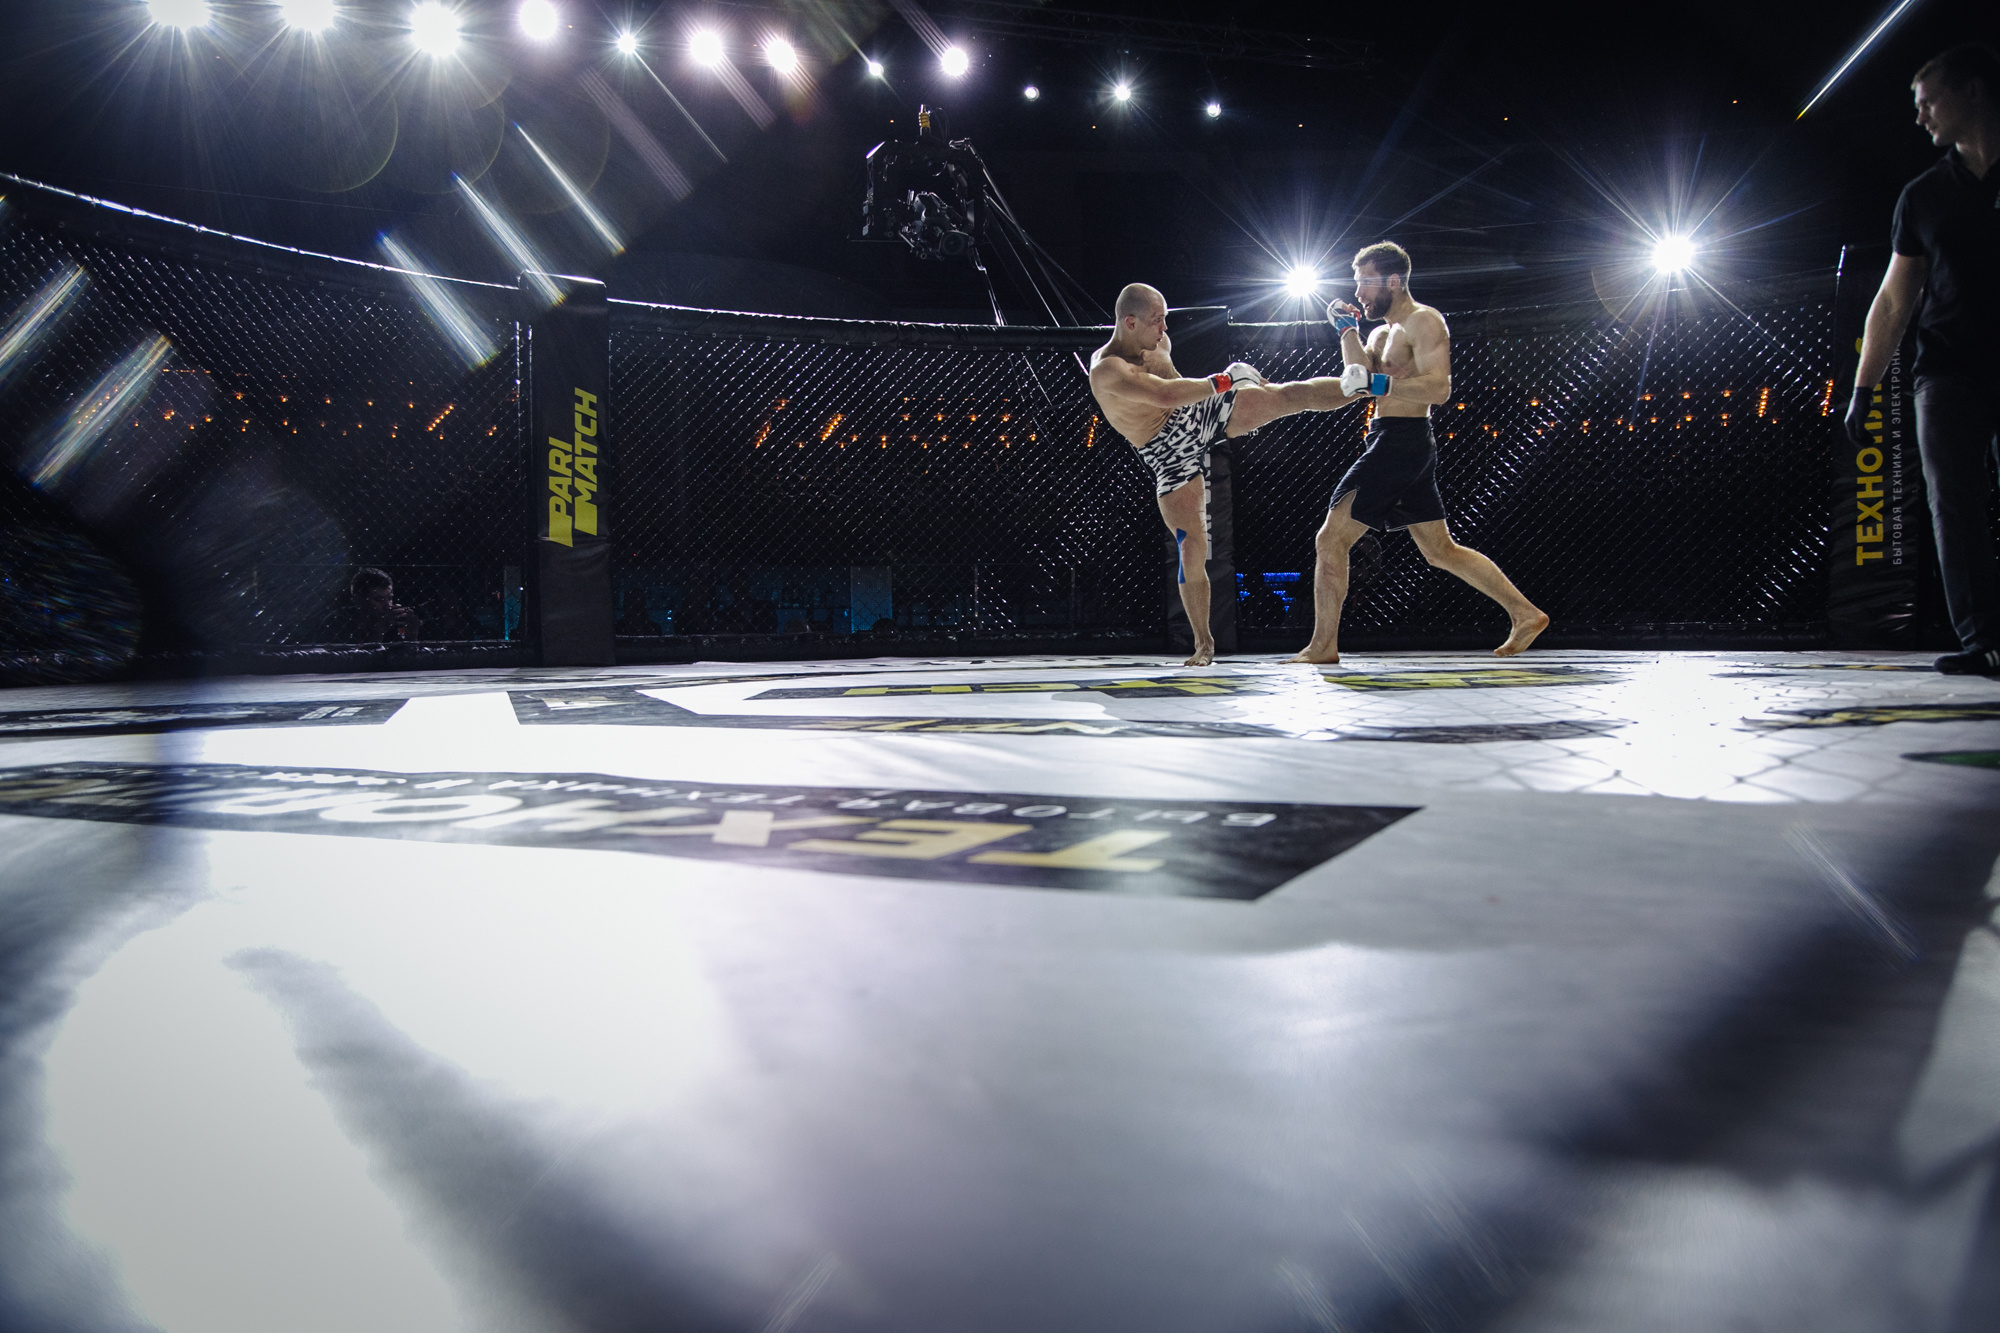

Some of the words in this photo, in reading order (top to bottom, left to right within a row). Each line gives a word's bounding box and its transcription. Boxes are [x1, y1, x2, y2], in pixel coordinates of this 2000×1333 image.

[574, 387, 597, 536] MATCH
[1892, 429, 1902, 438] И
[548, 436, 573, 548] PARI
[1892, 443, 1902, 502] ТЕХНИКА
[1892, 507, 1902, 566] БЫТОВАЯ
[836, 797, 1278, 829] БЫТОВАЯ
